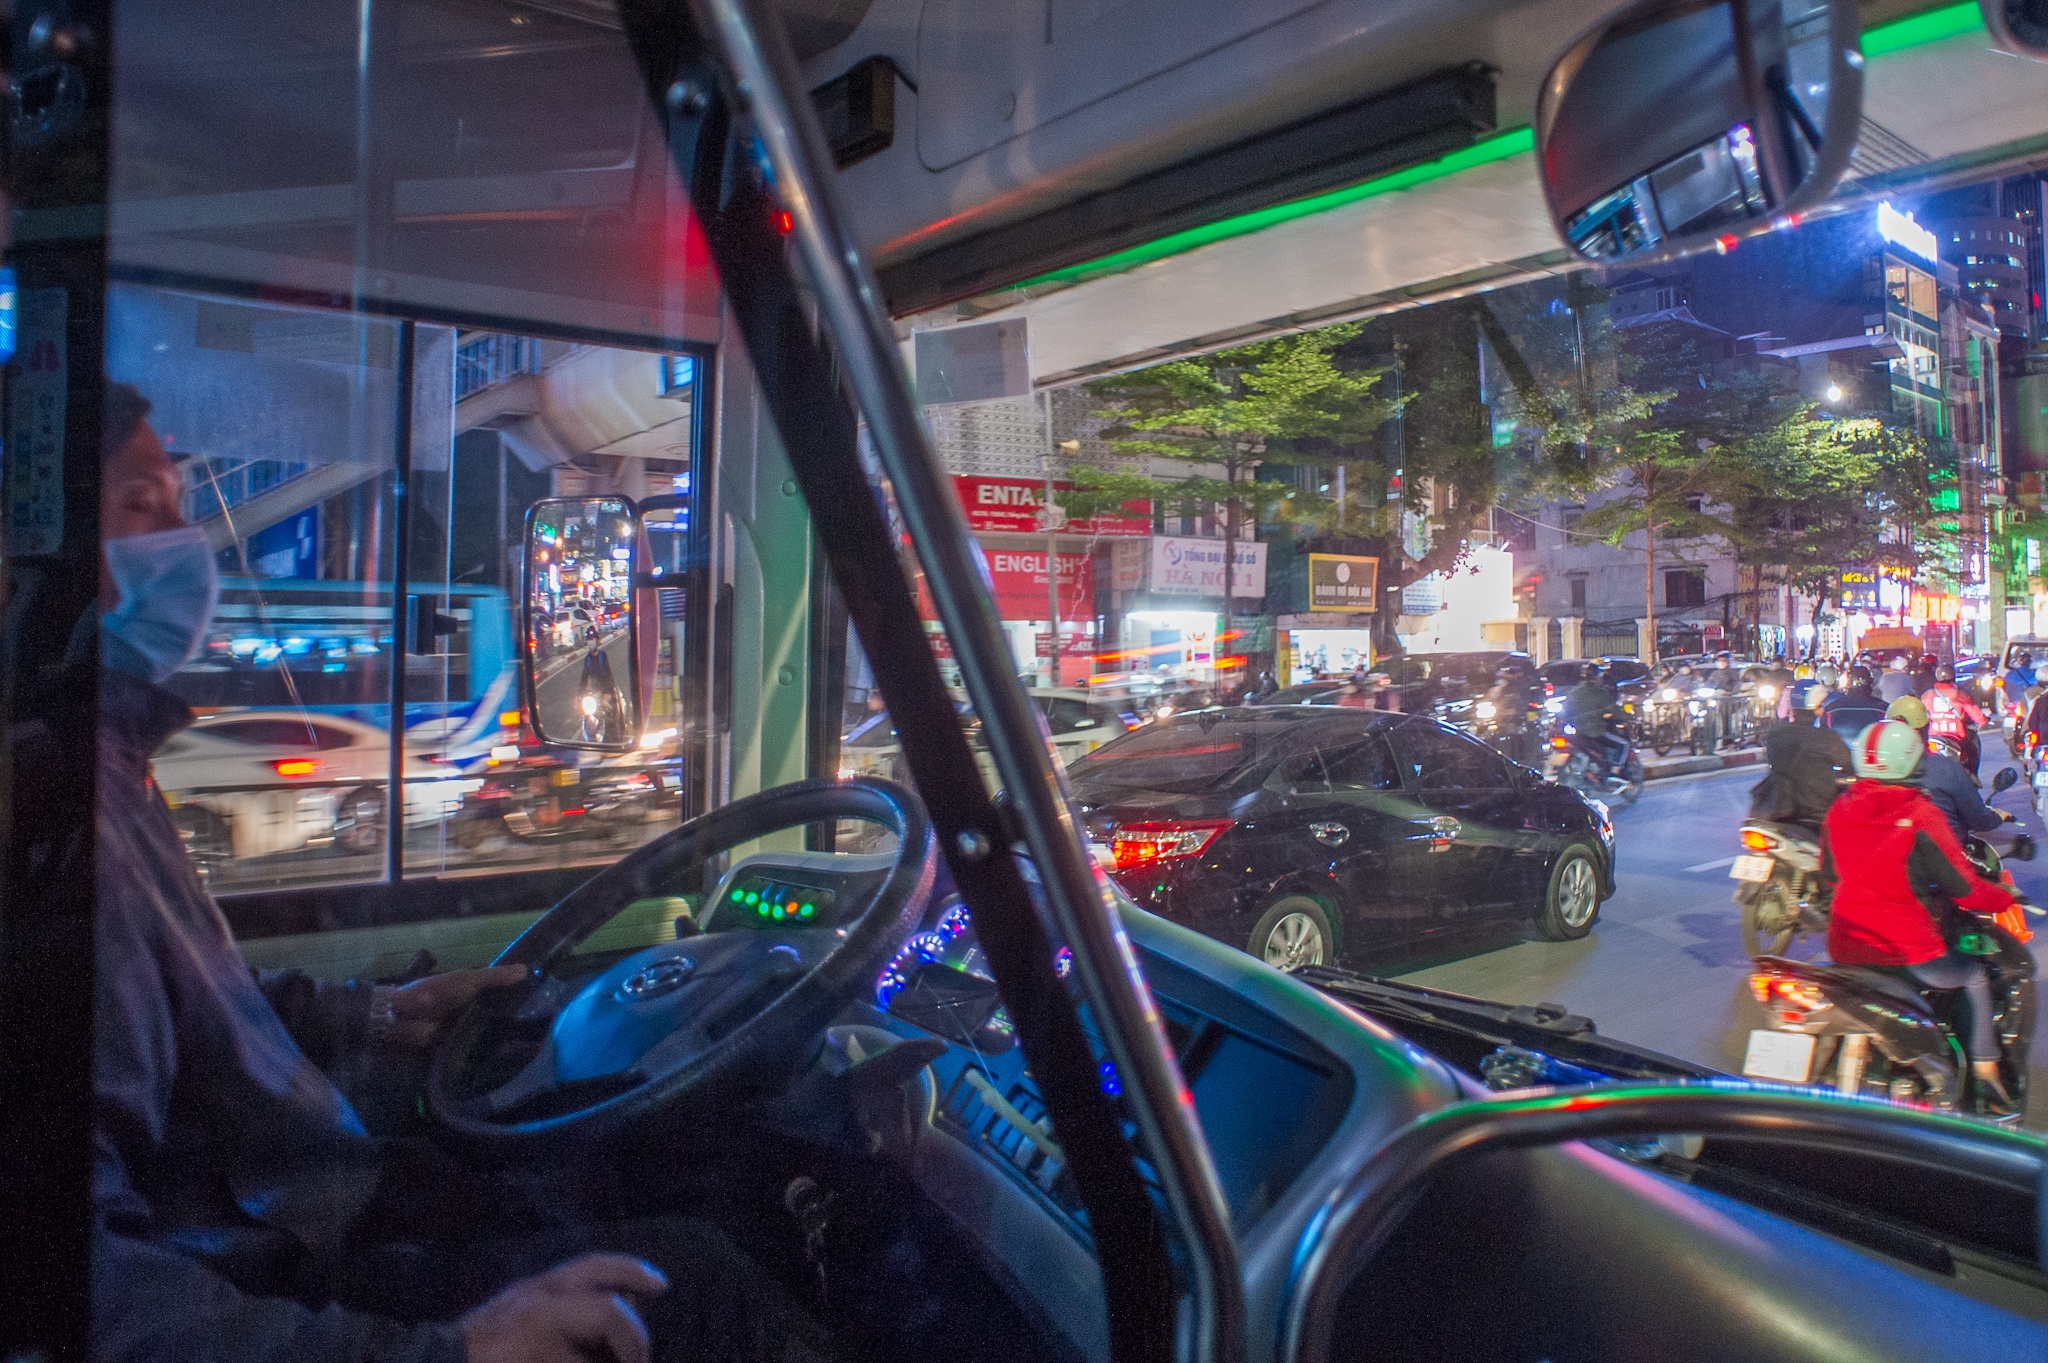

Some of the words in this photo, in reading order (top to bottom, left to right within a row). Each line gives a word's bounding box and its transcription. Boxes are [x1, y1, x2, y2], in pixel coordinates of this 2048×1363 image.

[994, 555, 1075, 574] ENGLISH
[1164, 563, 1194, 584] HÀ
[1246, 573, 1253, 587] 1
